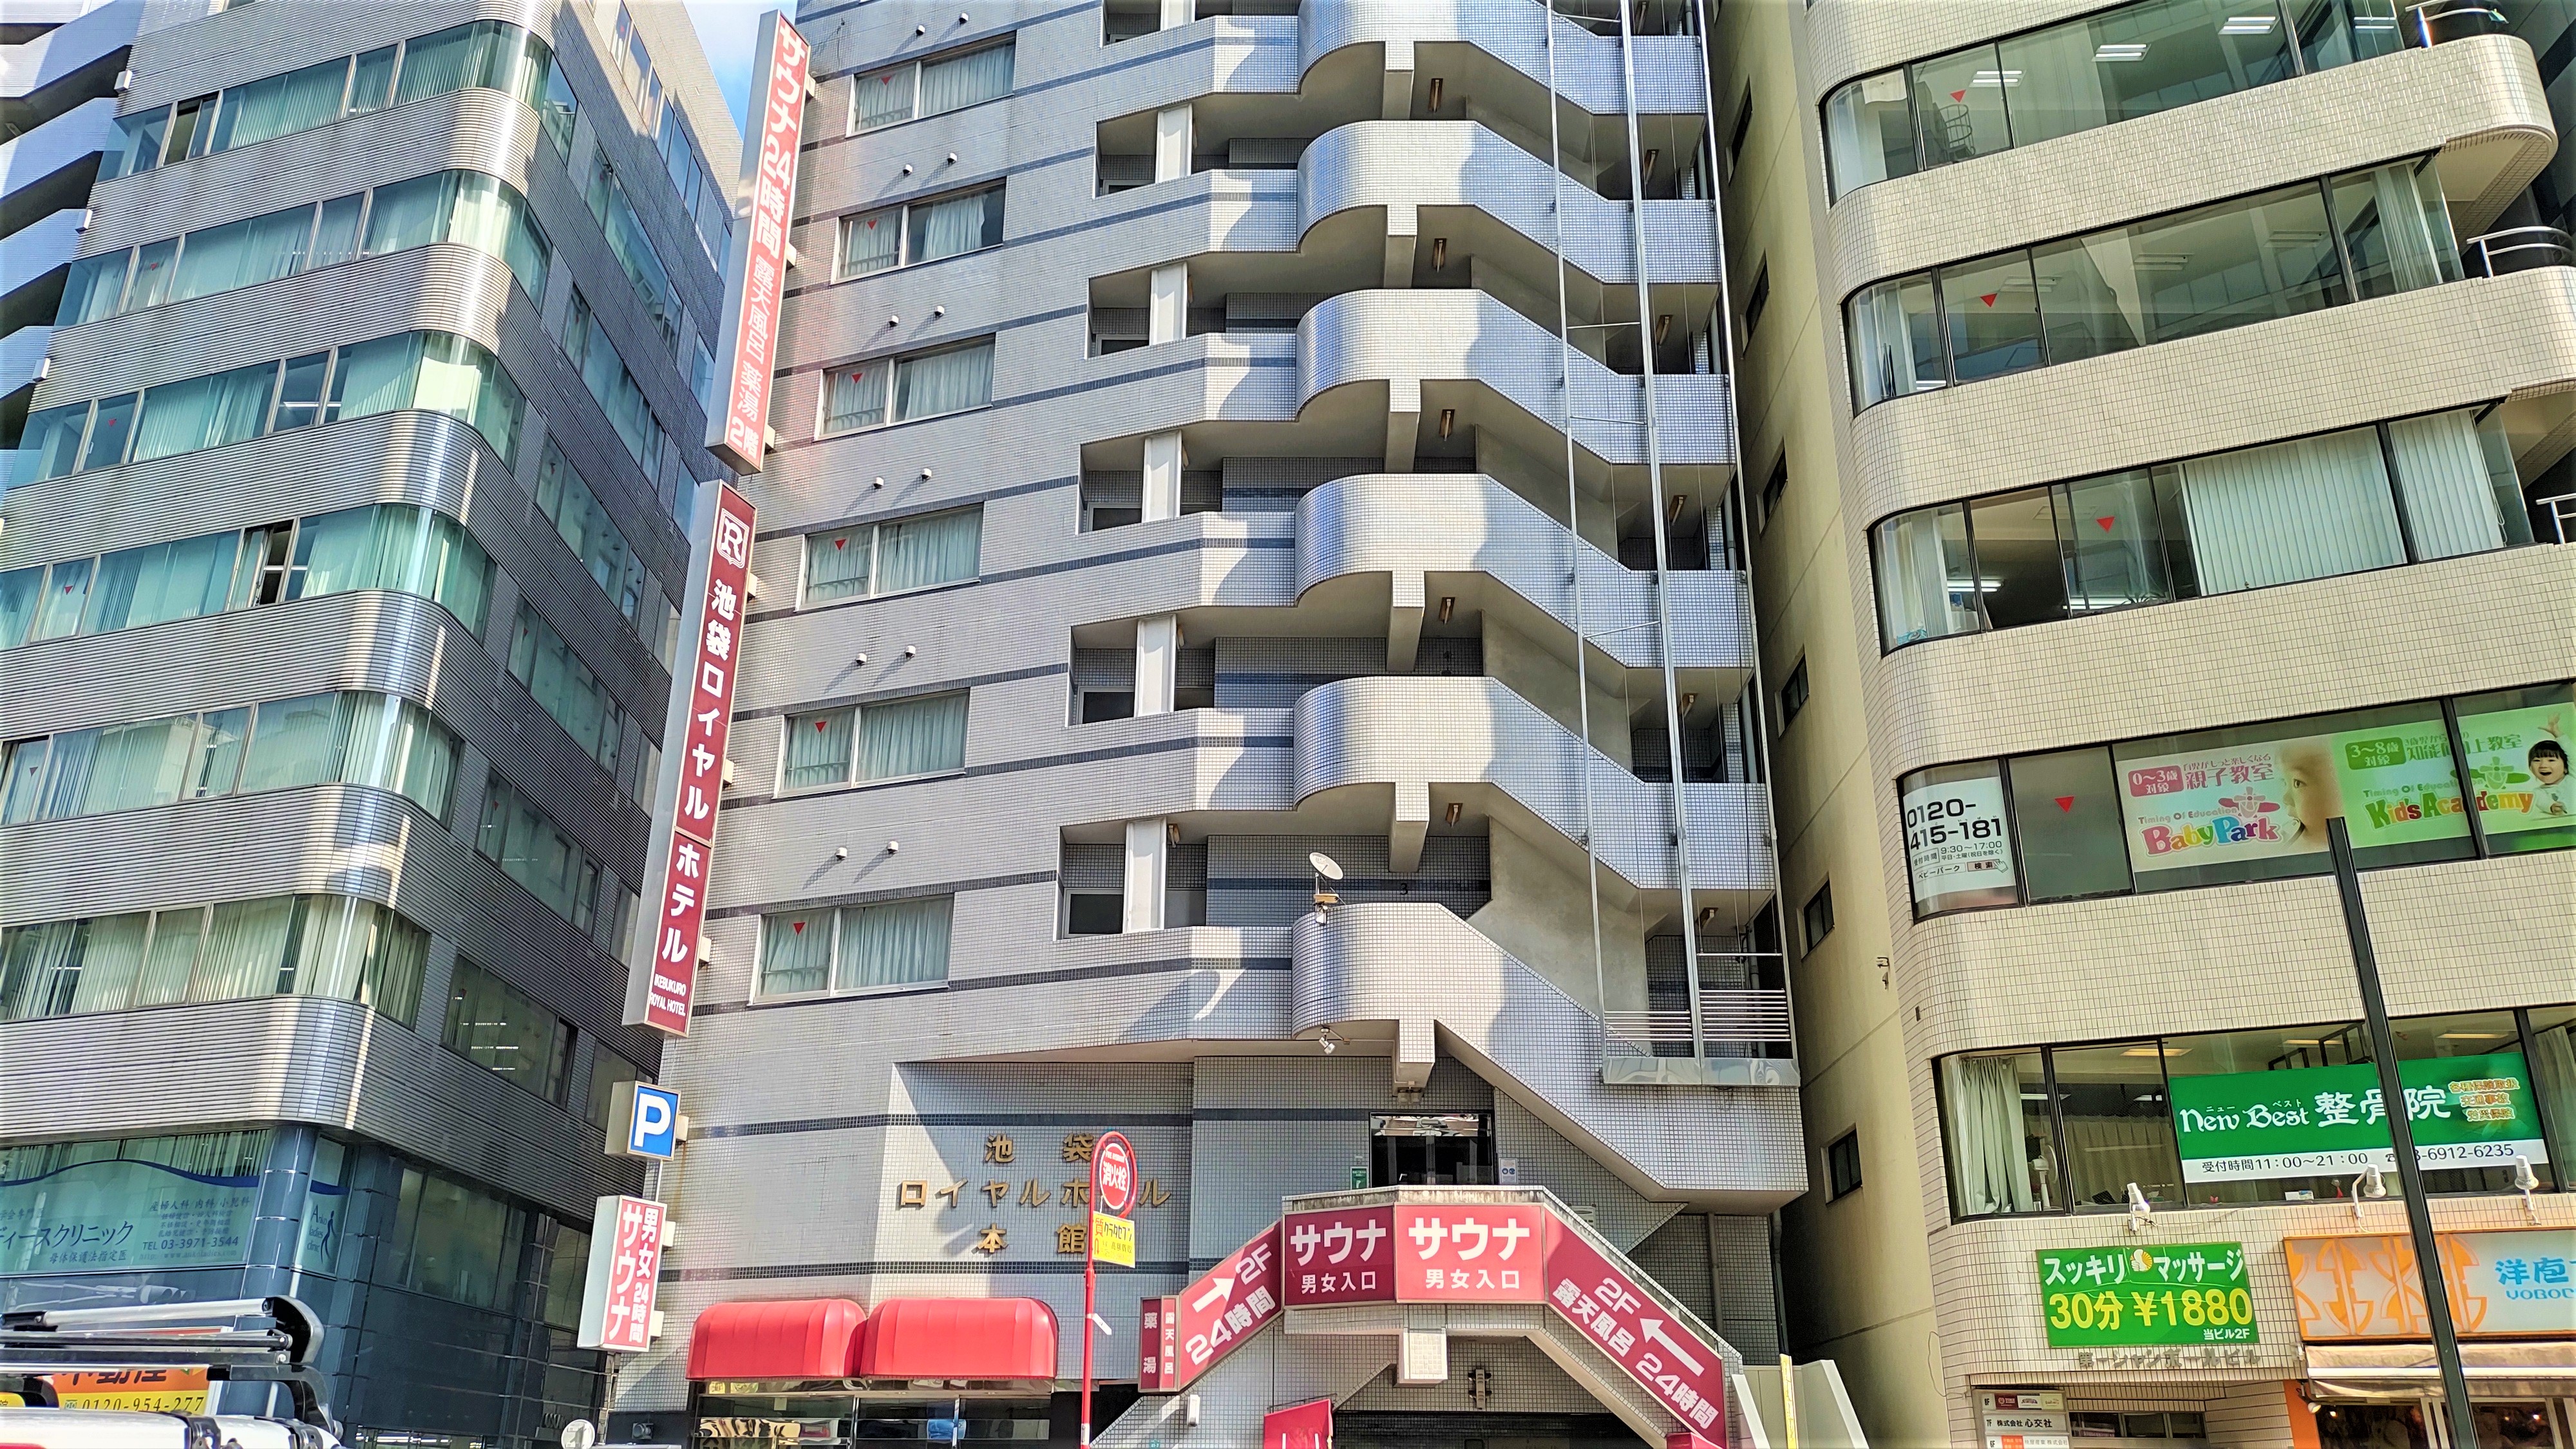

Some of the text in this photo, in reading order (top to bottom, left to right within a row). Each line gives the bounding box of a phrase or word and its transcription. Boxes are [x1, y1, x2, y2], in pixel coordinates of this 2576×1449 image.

[746, 254, 776, 365] 露天風呂
[737, 361, 763, 422] 薬湯
[730, 416, 760, 460] 2階
[2185, 763, 2275, 790] 親子教室
[2365, 755, 2391, 767] 対象
[2146, 783, 2170, 795] 対象
[2138, 814, 2171, 825] Timing
[2188, 808, 2238, 819] Education
[1910, 818, 2002, 851] 415-181
[1914, 853, 1937, 866] 受付時間
[1400, 882, 1408, 895] 3
[654, 973, 687, 997] IKEBUKURO
[649, 992, 687, 1017] ROYAL HOTEL
[2179, 1085, 2451, 1133] New Best 整骨院
[2460, 1092, 2511, 1107] 交通事故
[634, 1093, 672, 1148] P
[2414, 1144, 2515, 1161] 3-6912-6235
[1103, 1160, 1128, 1191] 消火栓
[898, 1178, 1171, 1208] ロイヤルホル
[1095, 1217, 1103, 1237] 質
[1290, 1218, 1387, 1266] サウナ
[1408, 1217, 1530, 1261] サウナ
[142, 1236, 239, 1251] TEL 03-3971-3544
[608, 1203, 643, 1342] サウナ
[628, 1206, 660, 1344] 男女 24時間
[1235, 1243, 1273, 1285] 2F
[1425, 1269, 1520, 1290] 男女入口
[2043, 1248, 2244, 1286] スッキリ マッサージ
[1301, 1270, 1377, 1294] 男女入口
[1594, 1277, 1642, 1315] 2F
[1185, 1285, 1276, 1366] 24時間
[2049, 1290, 2124, 1331] 30分
[1143, 1312, 1158, 1374] 薬湯
[1164, 1312, 1175, 1375] 露天風呂
[2203, 1327, 2251, 1341] 当ビル2F
[1552, 1278, 1636, 1358] 露天風呂
[1636, 1352, 1719, 1430] 24時間
[2025, 1418, 2053, 1428] 心交社
